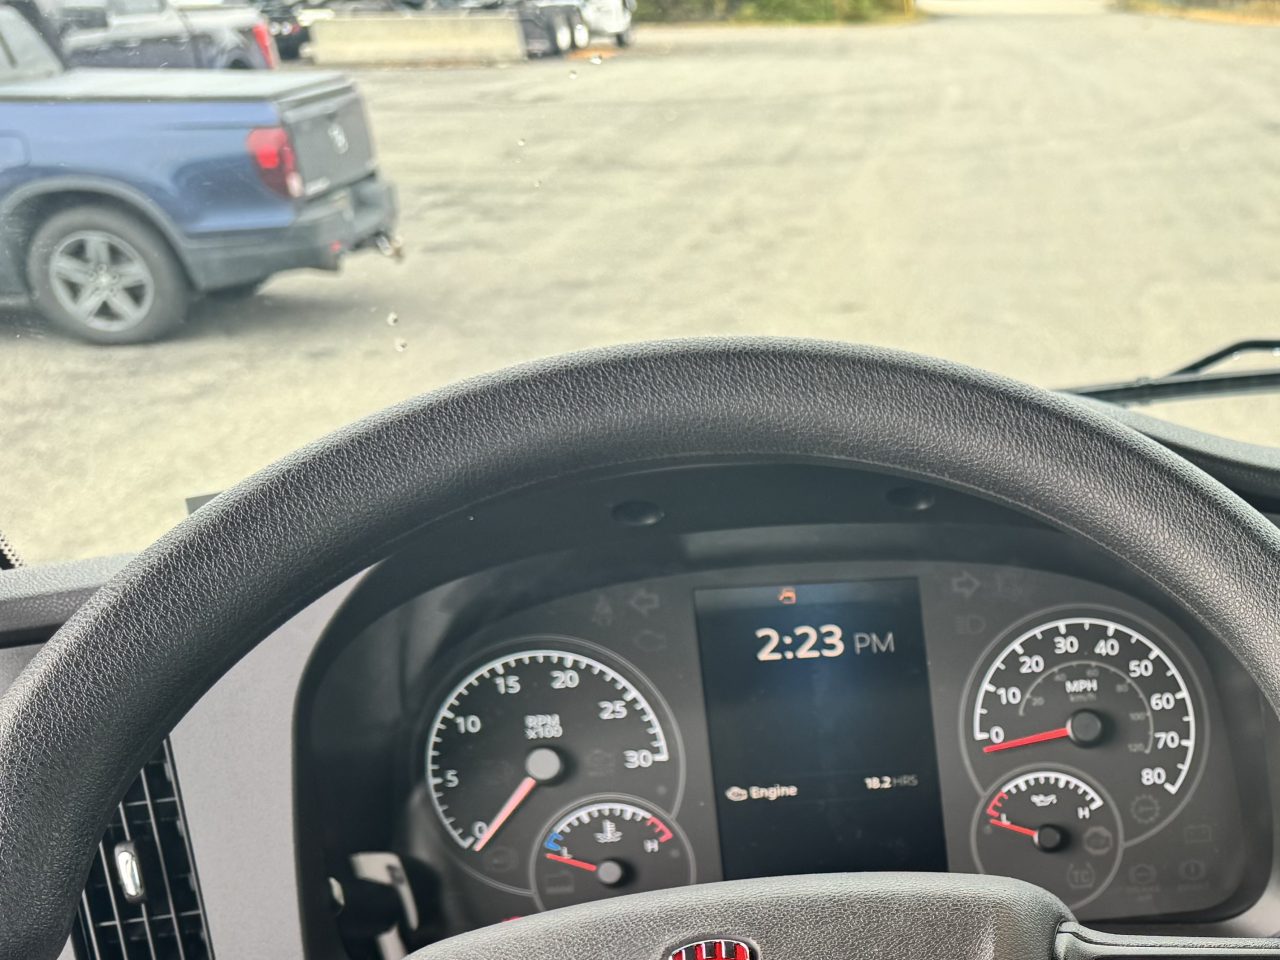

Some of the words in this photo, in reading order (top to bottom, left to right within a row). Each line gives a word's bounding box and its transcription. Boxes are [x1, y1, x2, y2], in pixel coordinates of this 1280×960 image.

[755, 624, 845, 661] 2:23
[854, 632, 895, 655] PM
[1053, 636, 1079, 654] 30
[1094, 638, 1120, 656] 40
[1019, 655, 1044, 674] 20
[1128, 659, 1153, 677] 50
[495, 676, 521, 694] 15
[551, 670, 579, 689] 20
[1065, 679, 1098, 693] MPH
[997, 687, 1021, 705] 10
[1150, 692, 1175, 710] 60
[598, 701, 627, 719] 25
[456, 715, 481, 733] 10
[525, 714, 560, 728] RPM
[989, 726, 1004, 744] 0
[1154, 731, 1179, 749] 70
[624, 750, 652, 768] 30
[445, 770, 459, 787] 5
[1141, 767, 1166, 785] 80
[750, 784, 798, 800] Engine
[1077, 806, 1090, 819] H
